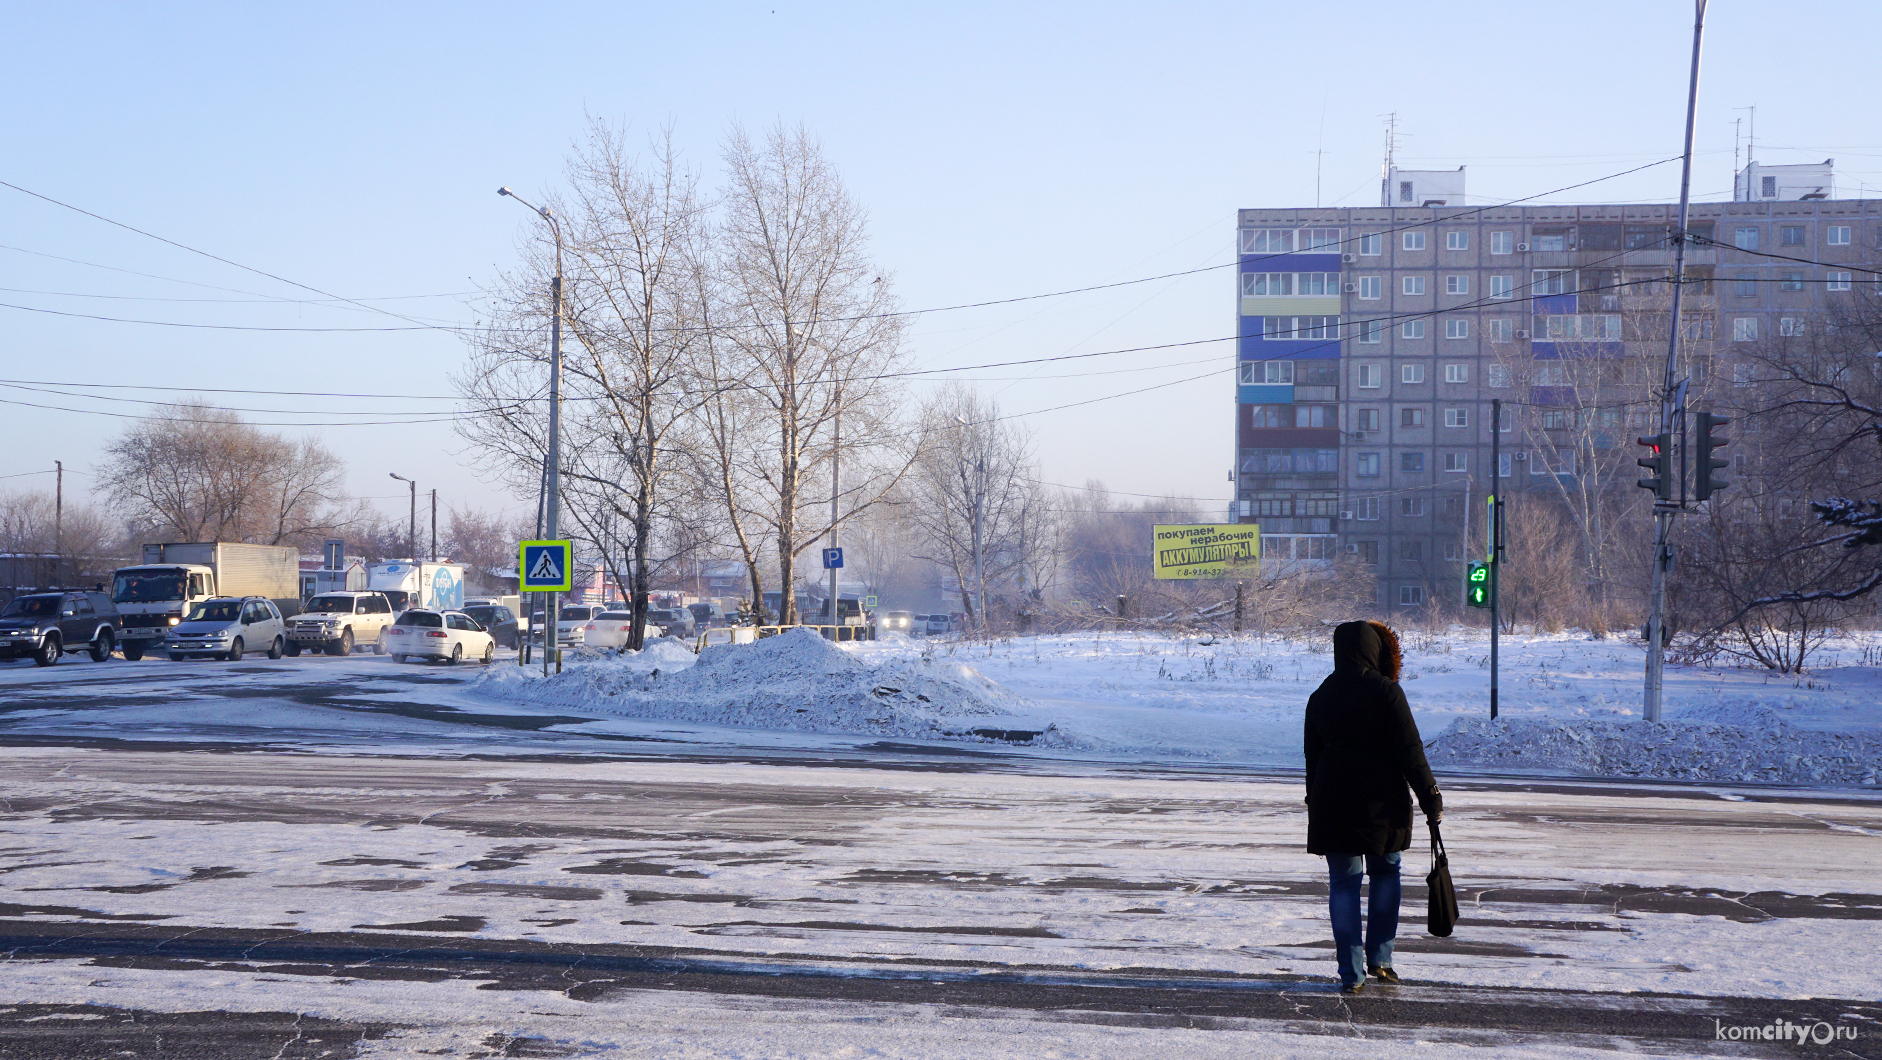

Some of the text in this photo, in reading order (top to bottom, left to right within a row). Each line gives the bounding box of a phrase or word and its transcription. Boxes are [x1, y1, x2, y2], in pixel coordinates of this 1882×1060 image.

[1157, 526, 1215, 541] покупаем
[1190, 531, 1254, 545] нерабочие
[828, 550, 840, 567] P
[1162, 542, 1250, 567] АККУМУЛЯТОРЫ
